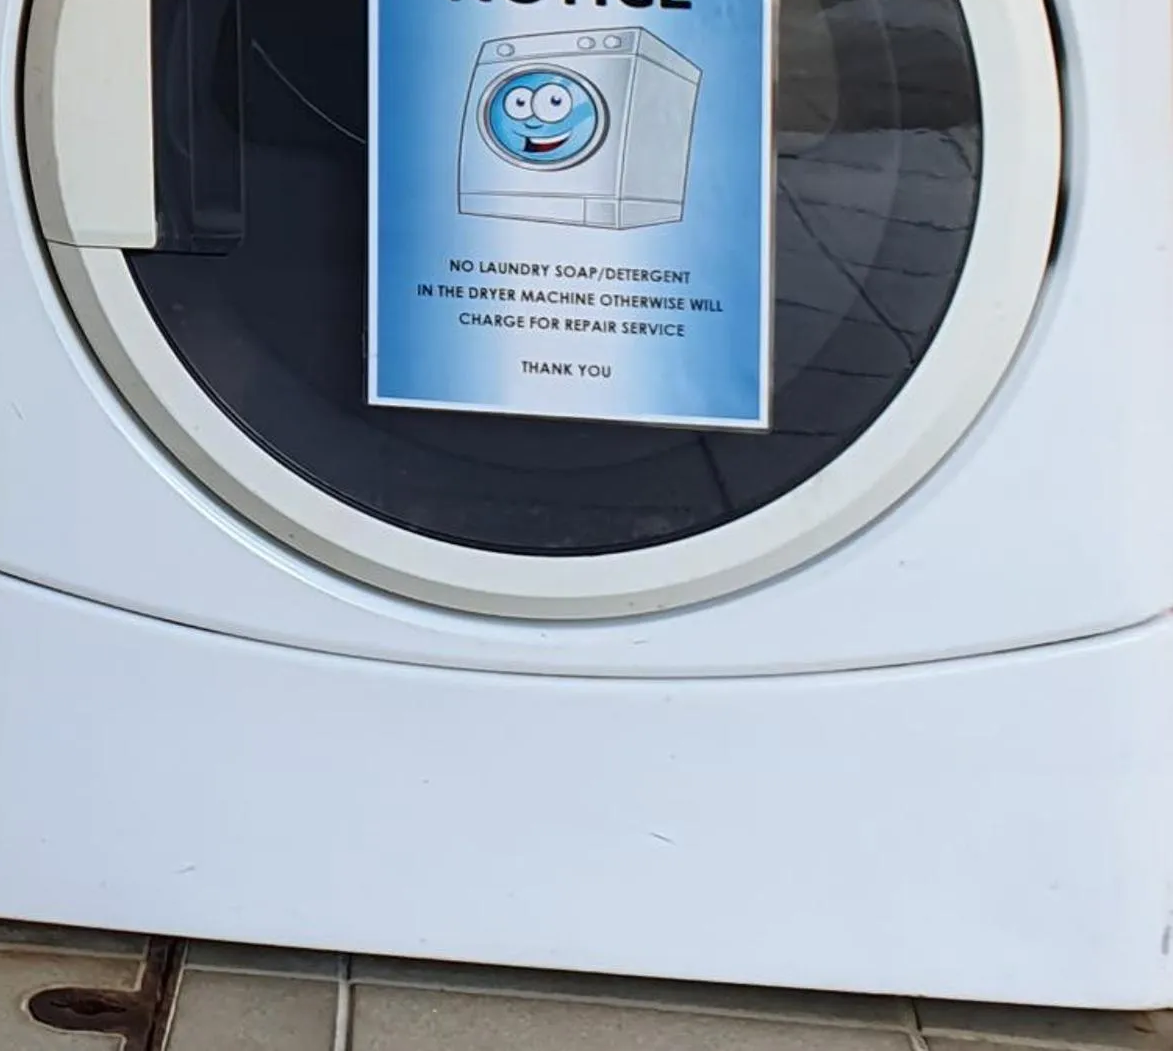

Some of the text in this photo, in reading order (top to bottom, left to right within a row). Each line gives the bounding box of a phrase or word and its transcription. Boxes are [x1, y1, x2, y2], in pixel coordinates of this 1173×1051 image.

[449, 259, 691, 285] NO LAUNDRY SOAP/DETERGENT
[417, 284, 724, 313] IN THE DRYER MACHINE OTHERWISE WILL
[459, 312, 686, 338] CHARGE FOR REPAIR SERVICE
[521, 360, 612, 379] THANK YOU
